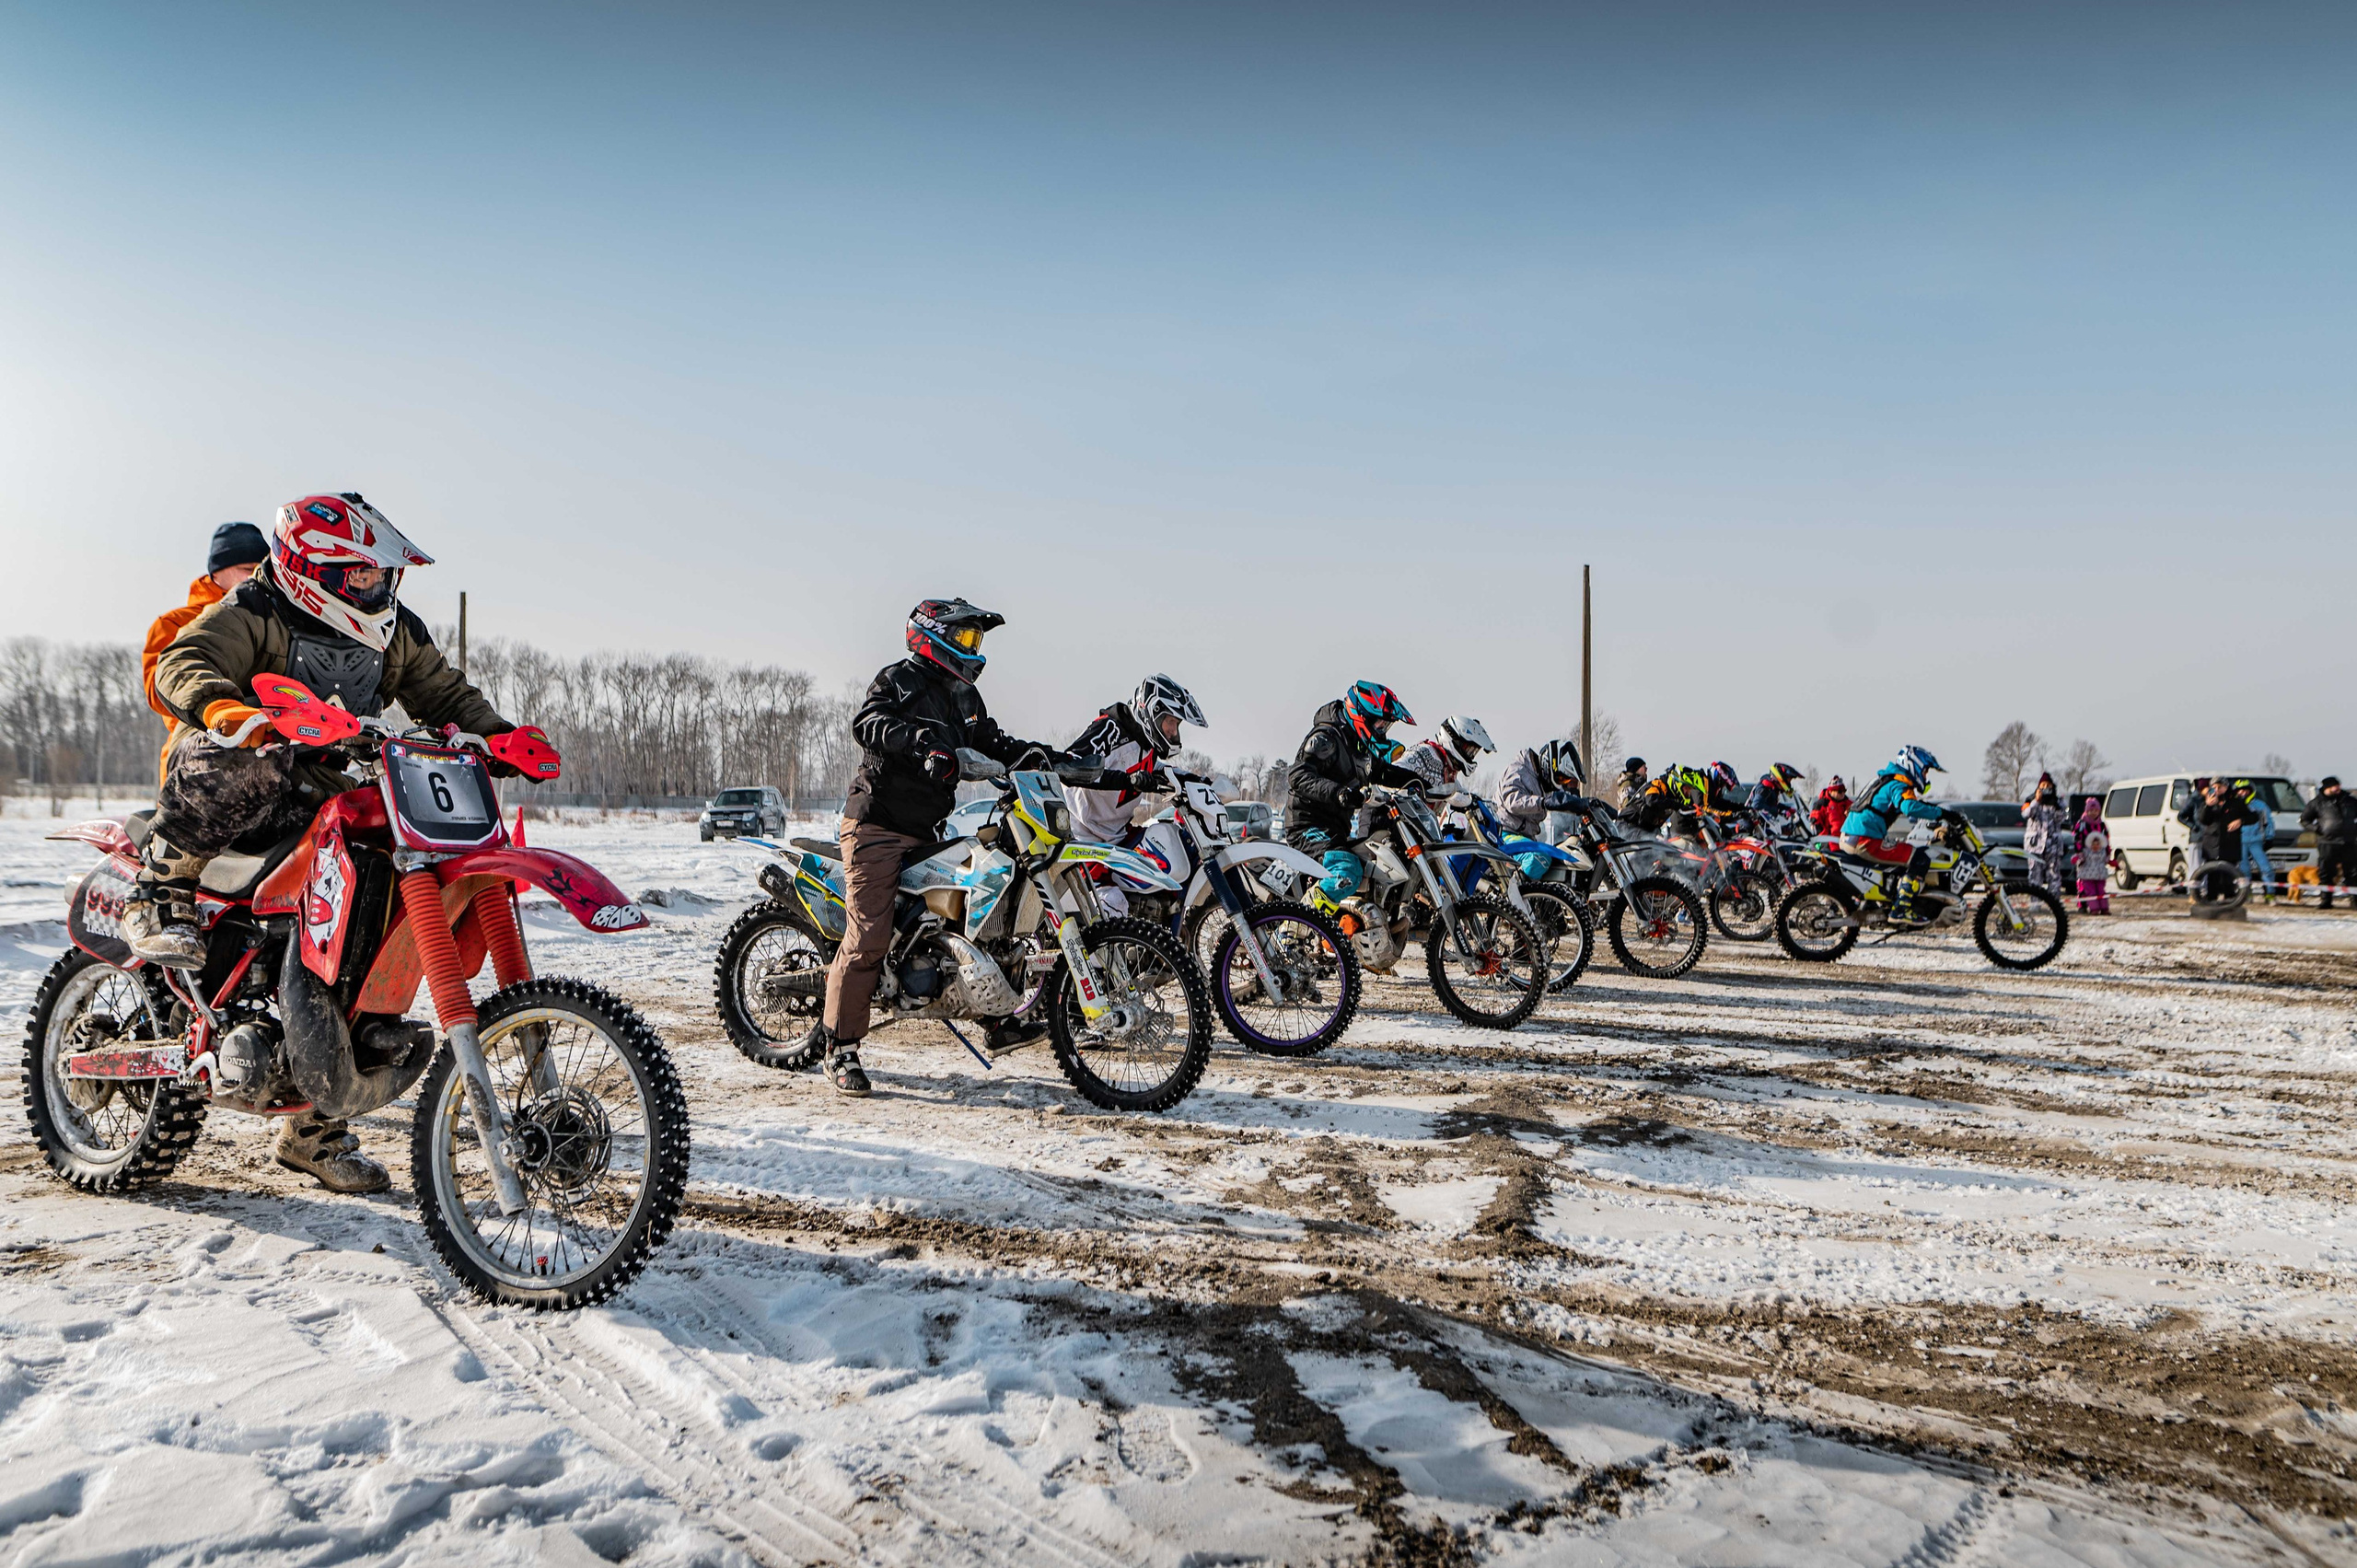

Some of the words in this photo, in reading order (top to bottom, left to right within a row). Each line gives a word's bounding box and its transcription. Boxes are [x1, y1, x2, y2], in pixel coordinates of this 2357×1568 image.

[314, 503, 339, 519] GoPro
[912, 612, 947, 634] 100%
[298, 726, 320, 738] CYCRA
[428, 772, 454, 813] 6
[1267, 865, 1292, 887] 101
[87, 883, 125, 921] 999
[223, 1055, 252, 1068] HONDA
